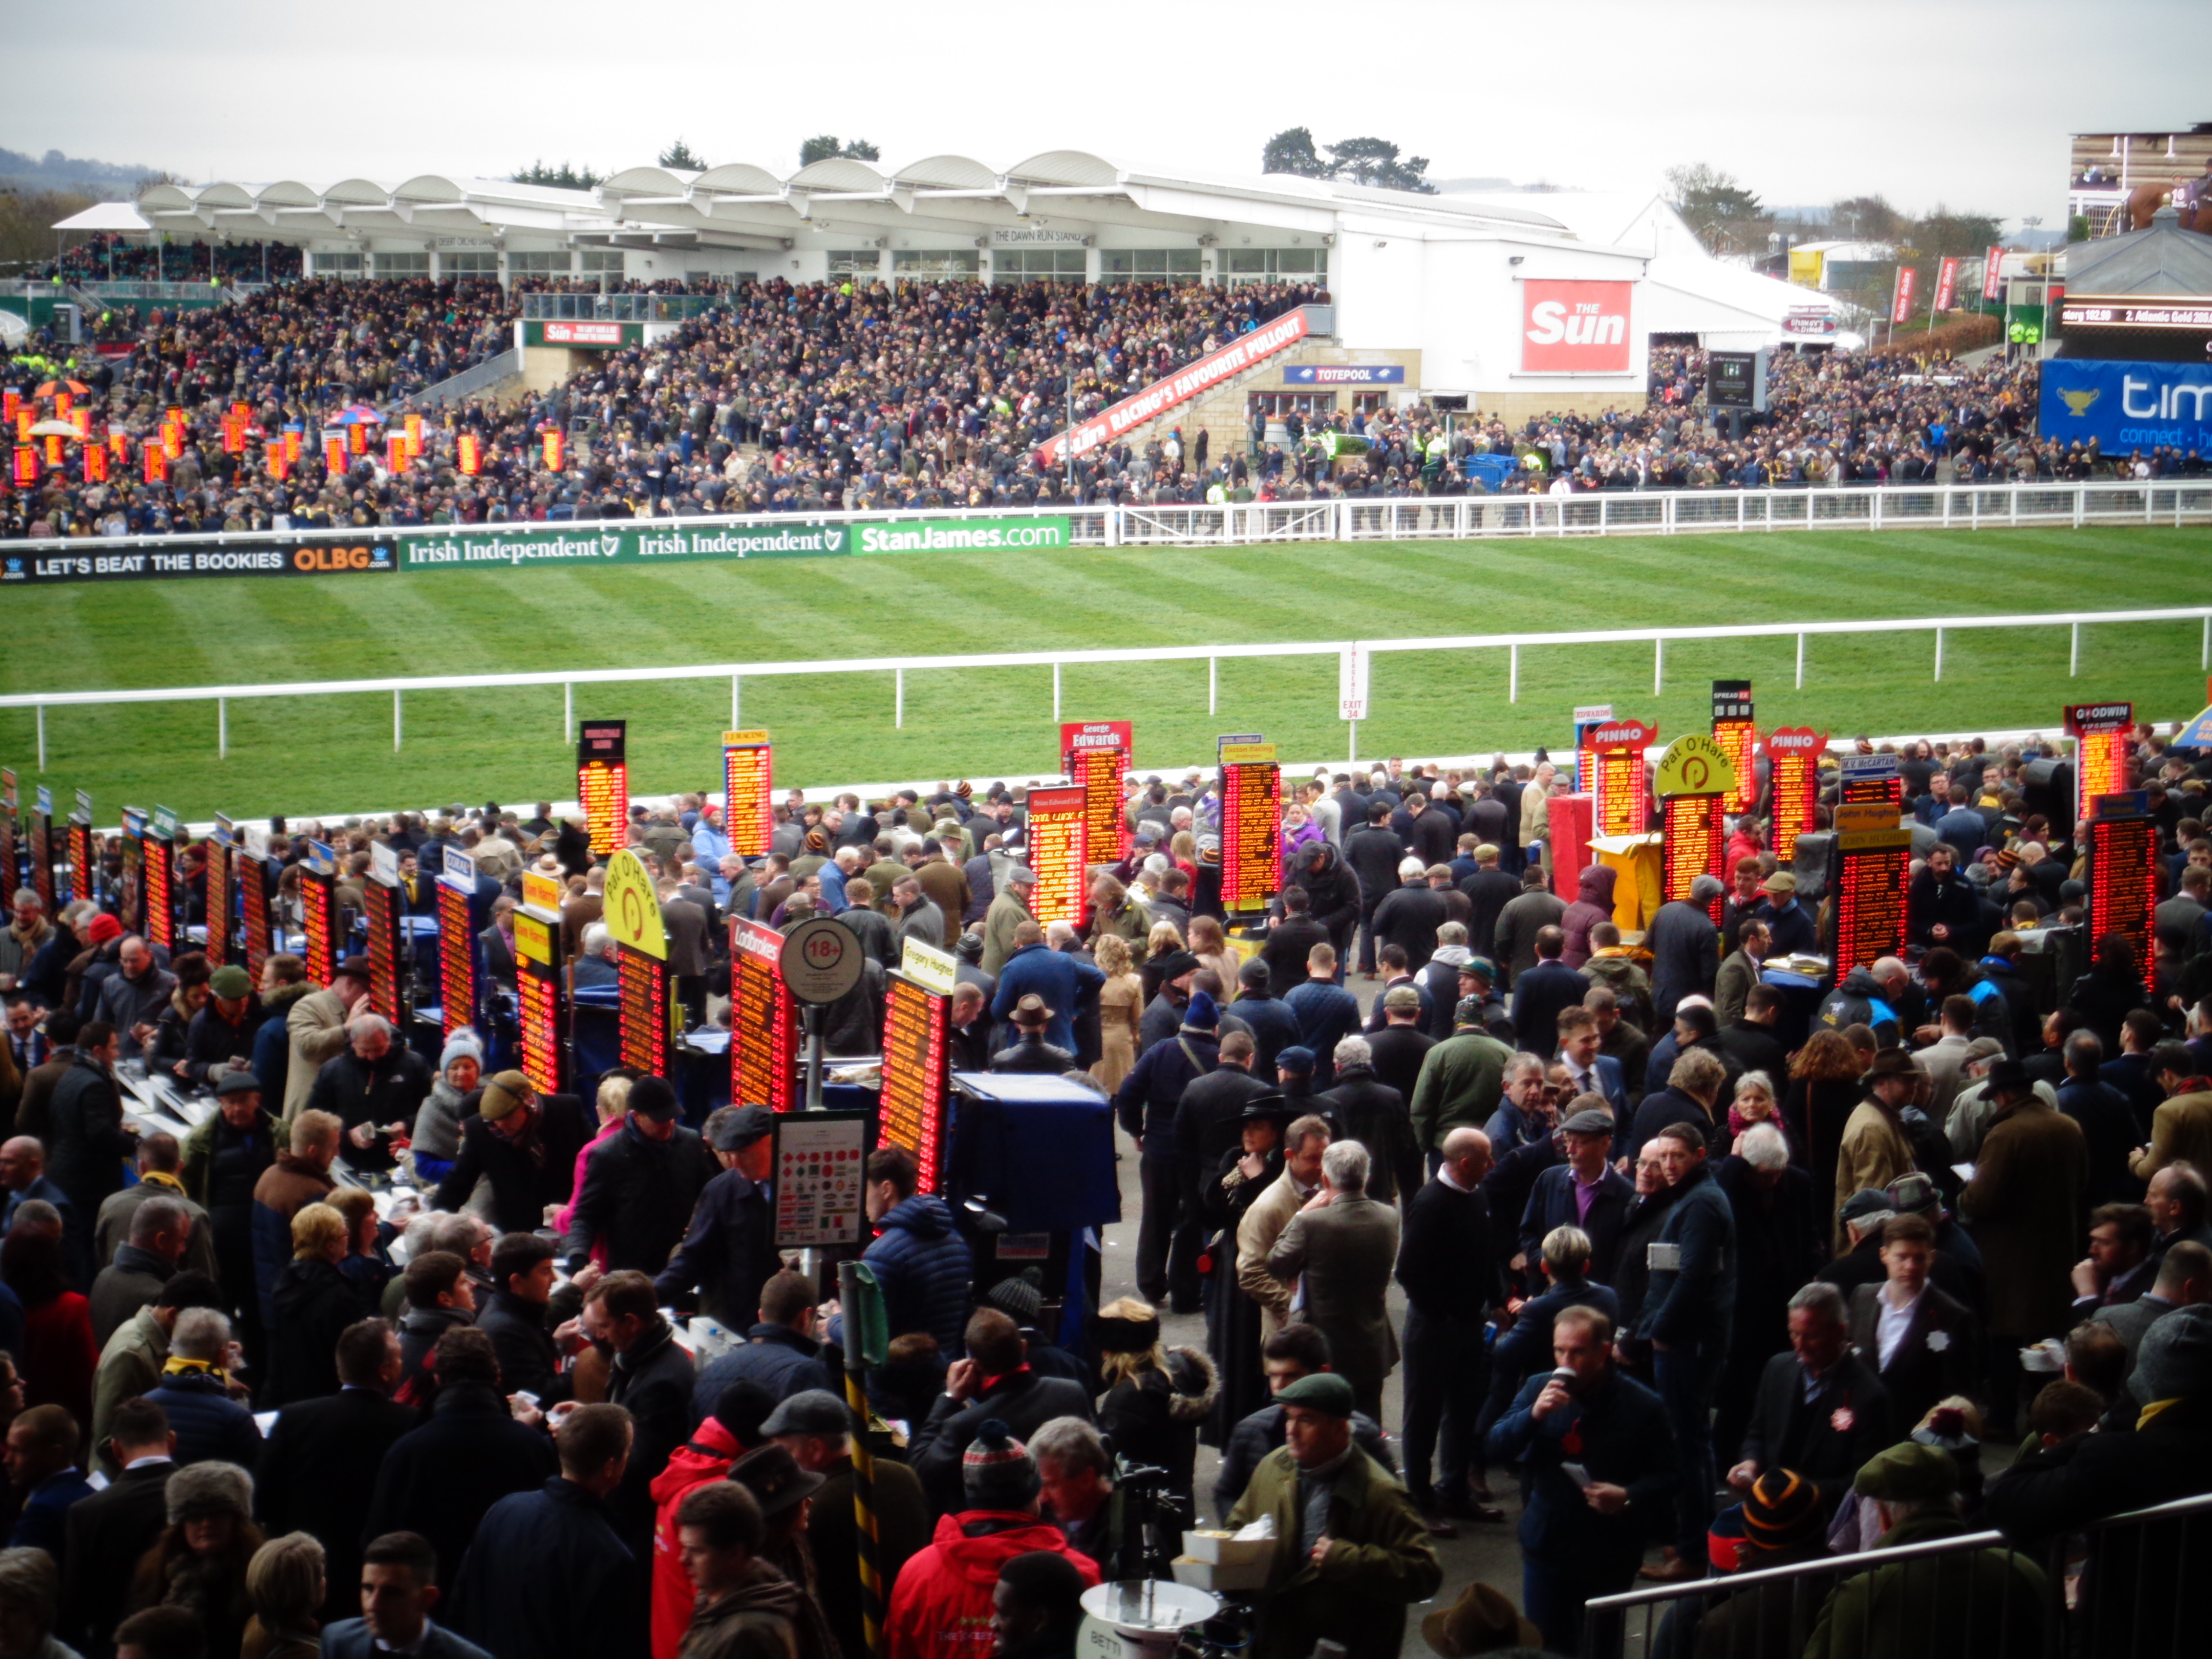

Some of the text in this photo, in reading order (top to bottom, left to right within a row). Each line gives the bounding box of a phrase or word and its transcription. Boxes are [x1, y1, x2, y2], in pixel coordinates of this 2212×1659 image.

[996, 231, 1081, 241] THE DAWN RUN STAND
[1576, 303, 1599, 315] THE
[2135, 310, 2170, 322] Atlantic
[2171, 311, 2192, 322] Gold
[1526, 301, 1626, 345] Sun
[547, 324, 571, 340] Sun
[1109, 385, 1174, 433] RACING'S
[1175, 346, 1247, 396] FAVOURITE
[1246, 316, 1300, 360] PULLOUT
[1317, 368, 1372, 382] TOTEPOOL
[2120, 428, 2183, 446] connect
[638, 530, 822, 558] Irish Independent
[861, 525, 1061, 552] StanJames.com
[408, 534, 598, 565] Irish Independent
[35, 558, 90, 576] LET'S
[95, 555, 144, 574] BEAT
[151, 553, 190, 572] THE
[195, 552, 283, 570] BOOKIES
[1343, 700, 1363, 709] EXIT
[2076, 705, 2128, 720] GOODWIN
[1347, 709, 1358, 719] 34
[1082, 724, 1110, 733] George
[1595, 728, 1642, 744] PINNO
[1073, 732, 1120, 747] Edwards
[1771, 735, 1814, 748] PINNO
[1661, 737, 1729, 772] Pat O'Hare
[1858, 757, 1895, 768] McCARTAN
[1839, 808, 1899, 820] John Hughes
[447, 853, 468, 874] CORAL
[525, 881, 557, 905] Sam Harris
[606, 854, 656, 918] Pat O'Hare
[735, 924, 778, 961] Ladbrokes
[809, 940, 840, 957] 18+
[905, 945, 954, 977] Gregory Hughes
